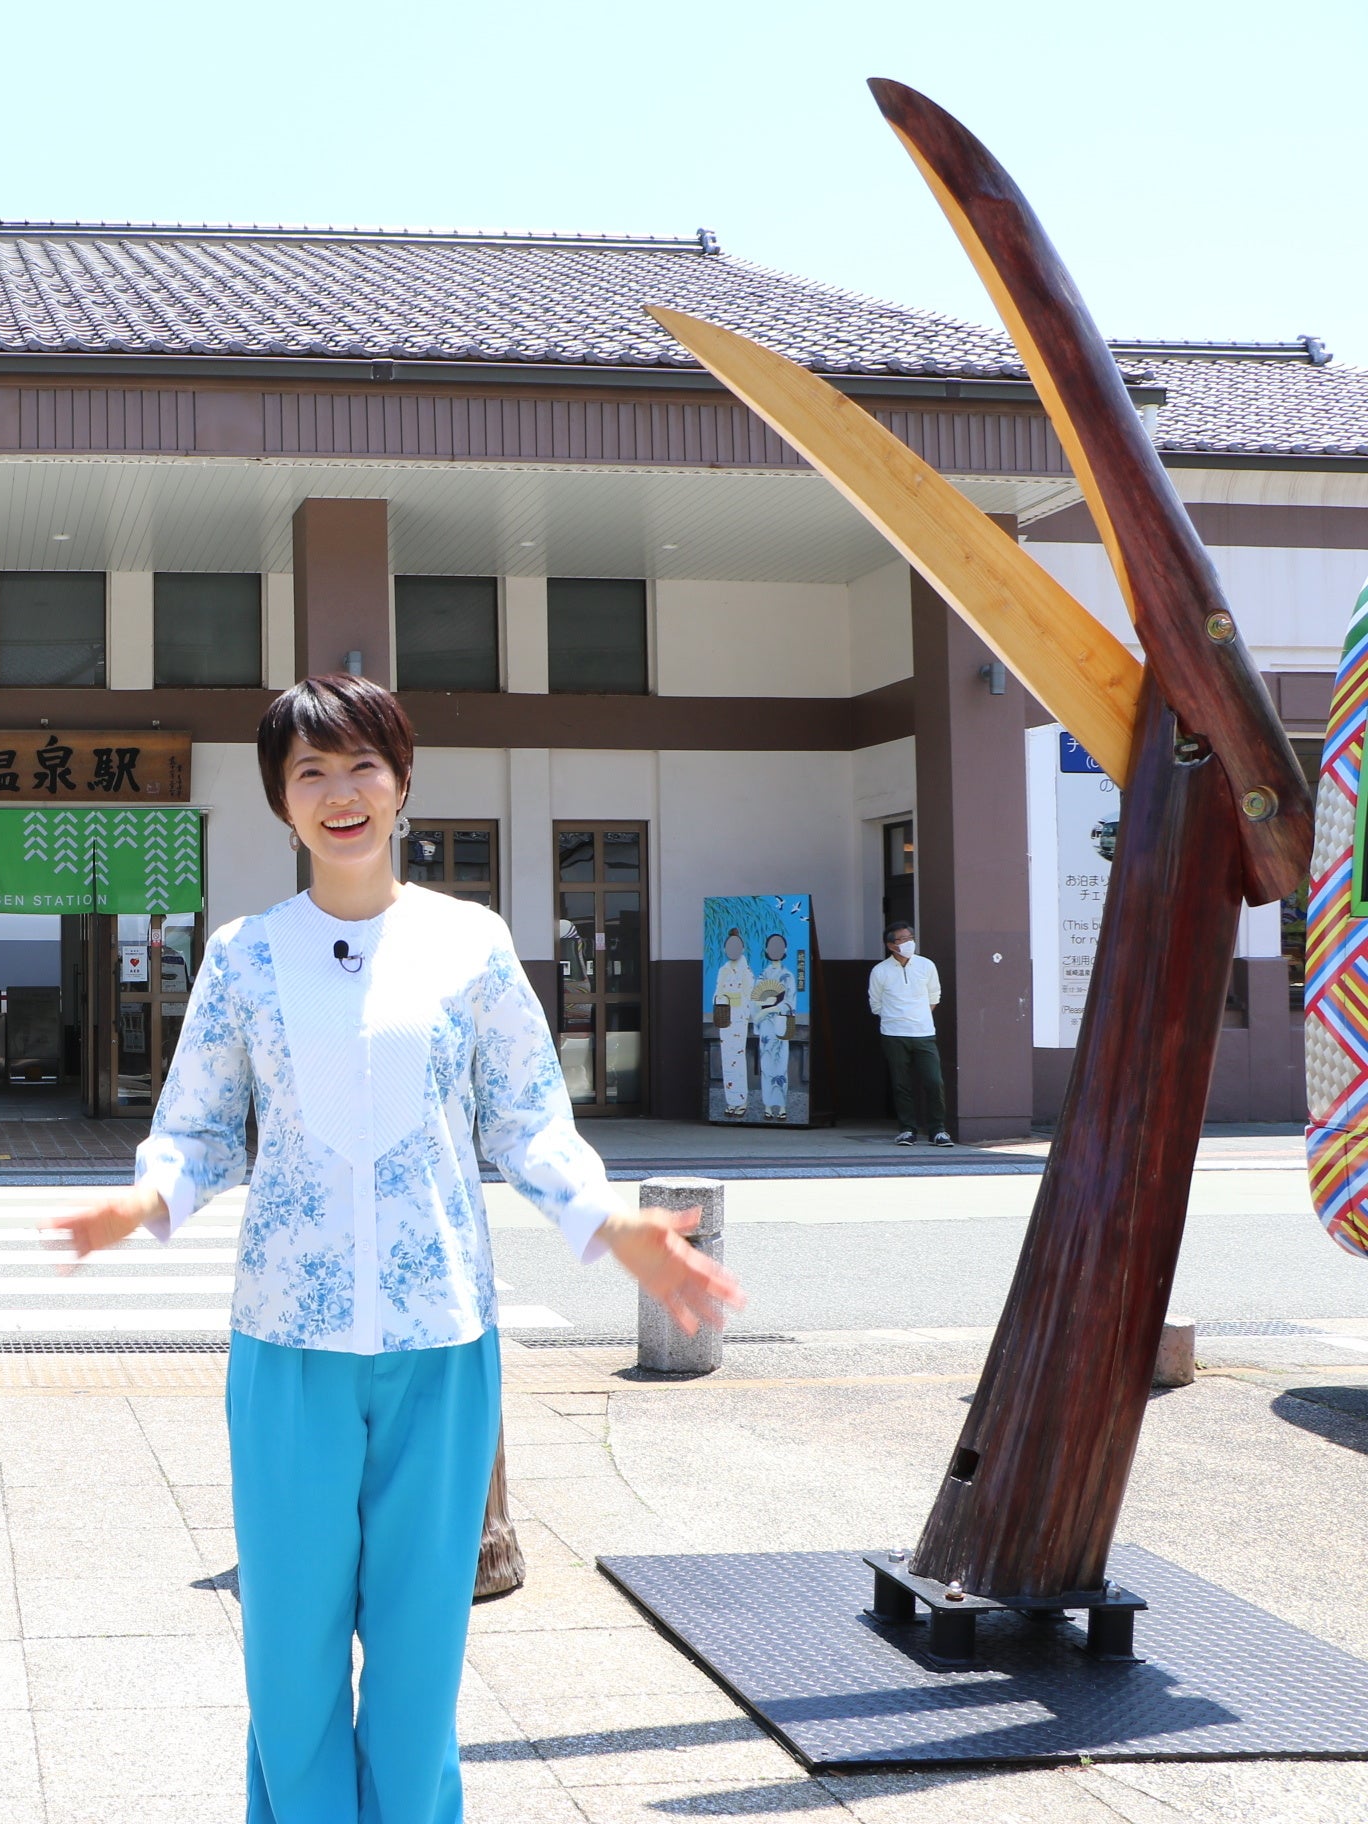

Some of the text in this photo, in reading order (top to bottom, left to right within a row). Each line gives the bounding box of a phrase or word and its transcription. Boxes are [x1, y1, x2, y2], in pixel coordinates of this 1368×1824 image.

[33, 894, 107, 906] STATION
[1080, 889, 1106, 901] チェ
[1062, 919, 1089, 931] (This
[1070, 934, 1086, 945] for
